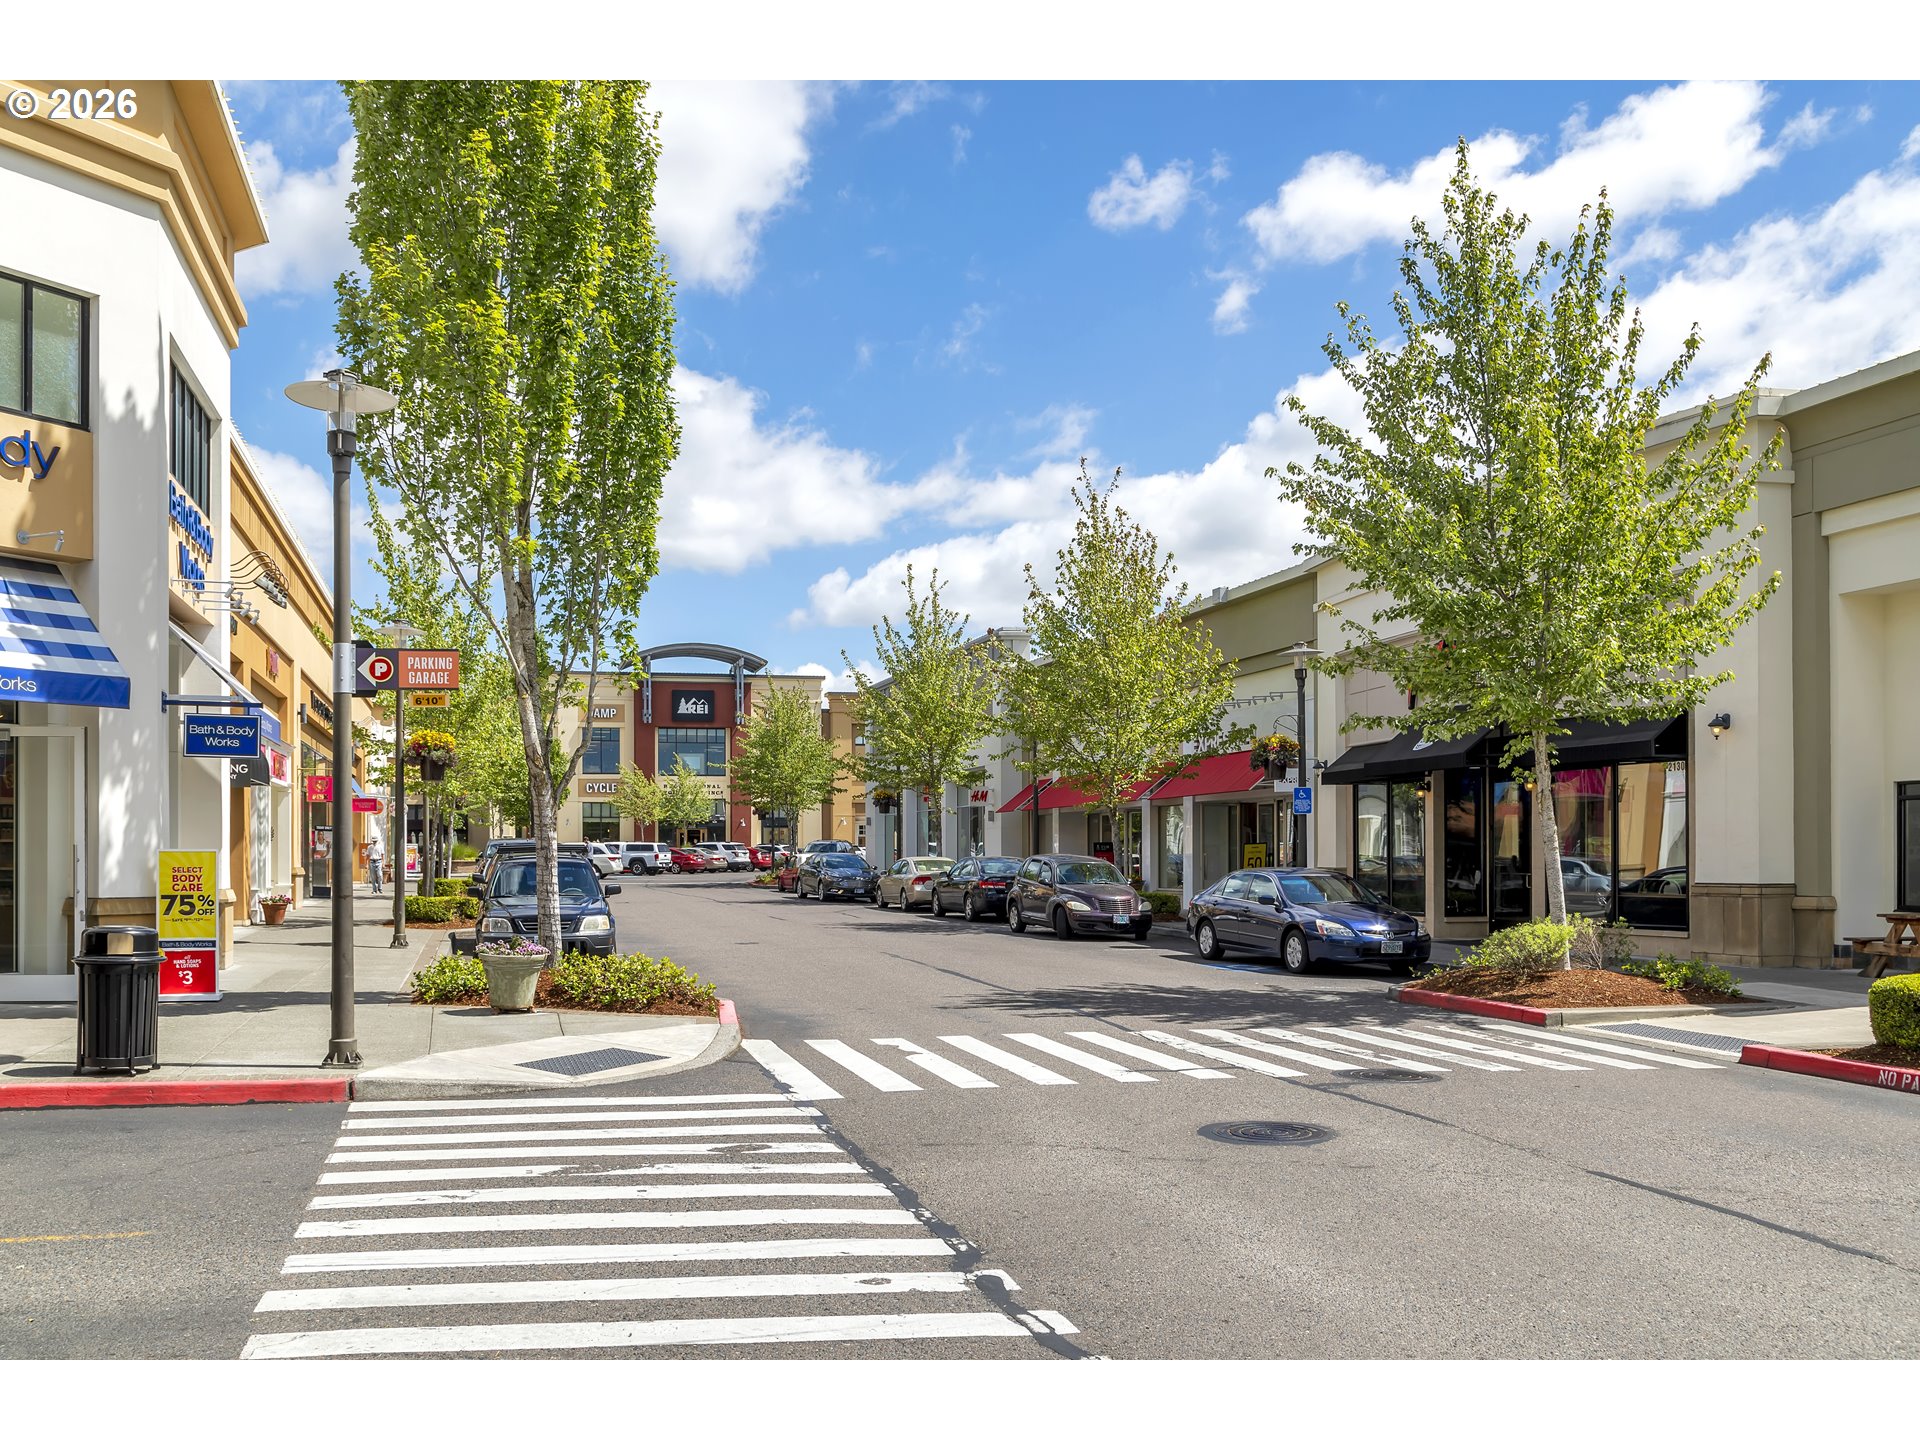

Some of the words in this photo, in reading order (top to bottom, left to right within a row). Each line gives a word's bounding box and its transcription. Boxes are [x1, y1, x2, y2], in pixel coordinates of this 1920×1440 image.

[407, 656, 453, 670] PARKING
[0, 676, 37, 692] orks
[408, 671, 450, 684] GARAGE
[415, 696, 443, 705] 6'10"
[591, 708, 617, 718] AMP
[189, 724, 215, 734] Bath
[216, 725, 225, 735] &
[226, 725, 255, 737] Body
[205, 736, 240, 747] Works
[1668, 761, 1685, 772] 2130
[586, 782, 617, 793] CYCLE
[971, 790, 988, 803] H&M
[172, 884, 203, 892] CARE
[161, 895, 215, 915] 75%
[178, 970, 193, 985] $3
[1878, 1069, 1897, 1087] NO
[1901, 1073, 1920, 1091] PA
